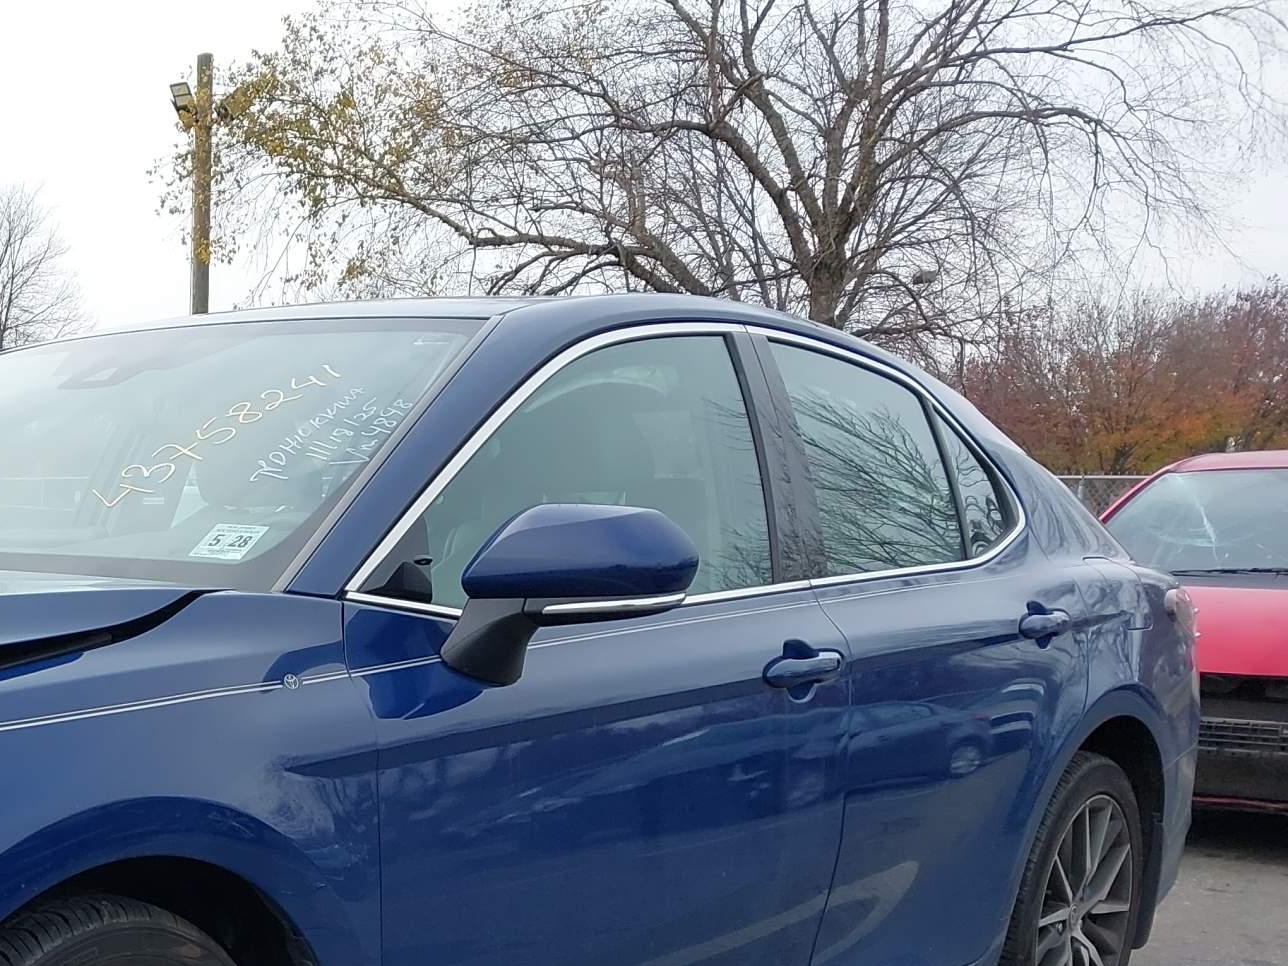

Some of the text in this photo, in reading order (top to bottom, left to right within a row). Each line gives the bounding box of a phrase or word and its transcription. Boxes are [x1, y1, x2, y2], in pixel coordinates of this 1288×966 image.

[92, 364, 342, 508] 43758241
[207, 533, 253, 548] 5 28
